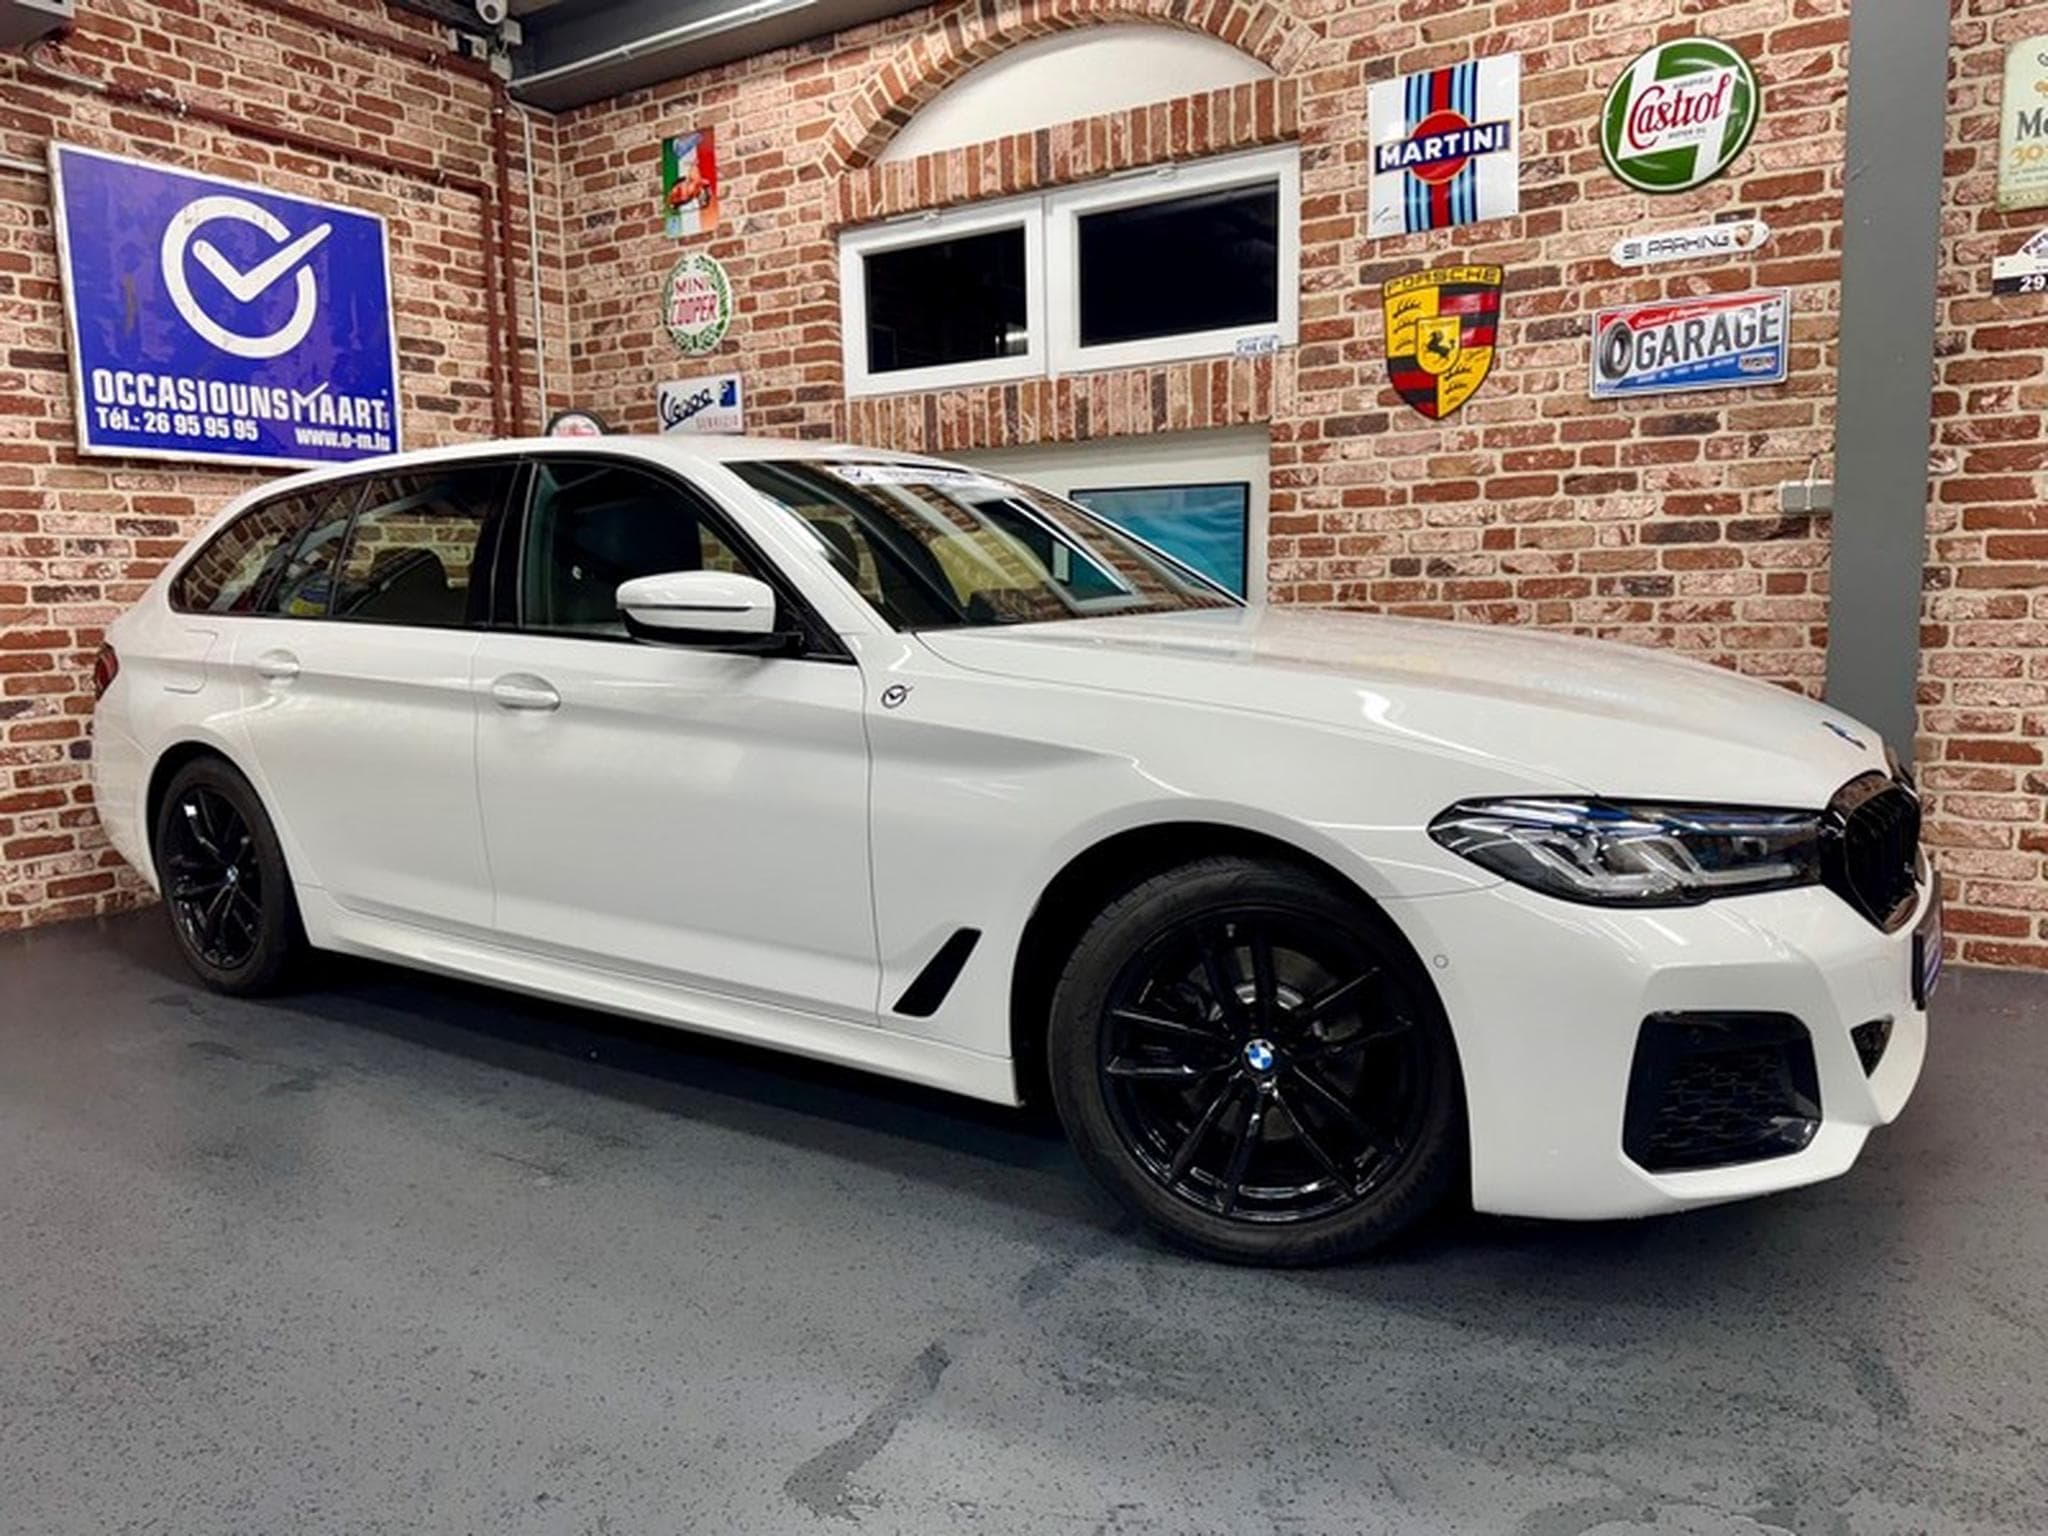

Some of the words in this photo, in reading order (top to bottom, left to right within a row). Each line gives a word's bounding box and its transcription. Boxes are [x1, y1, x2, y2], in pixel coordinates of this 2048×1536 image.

[1628, 73, 1732, 150] Castrol
[1380, 125, 1504, 169] MARTINI
[1647, 230, 1729, 255] PARKING
[675, 276, 710, 294] MINI
[1388, 269, 1496, 295] PORSCHE
[1635, 300, 1781, 370] GARAGE
[661, 387, 714, 430] Vespa
[144, 413, 170, 434] 26
[174, 416, 200, 437] 95
[204, 418, 230, 440] 95
[234, 421, 259, 442] 95
